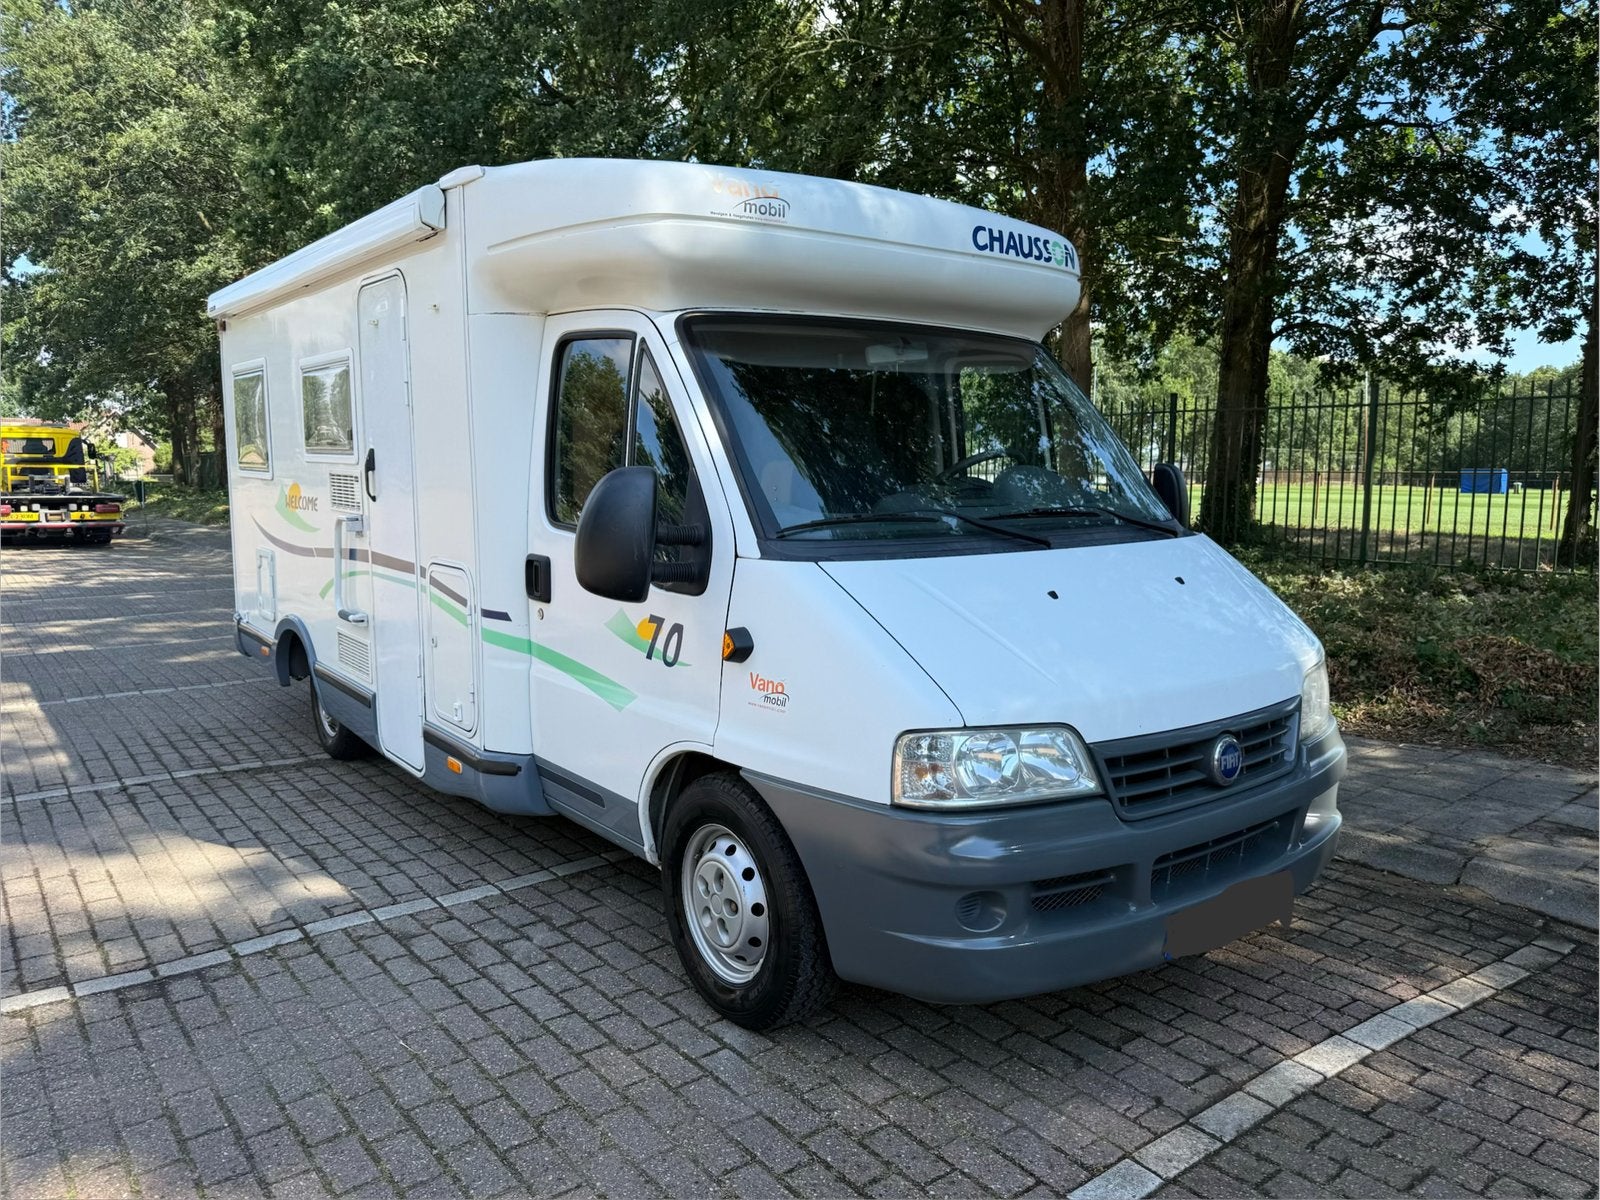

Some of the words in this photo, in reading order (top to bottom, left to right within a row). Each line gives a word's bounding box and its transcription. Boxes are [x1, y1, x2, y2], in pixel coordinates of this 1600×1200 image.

[743, 201, 786, 218] mobil
[972, 225, 1076, 270] CHAUSSON
[285, 494, 319, 512] WELCOME
[646, 613, 684, 668] 70
[750, 671, 785, 694] Vano
[763, 695, 787, 707] mobil
[1221, 752, 1239, 771] FIAT
